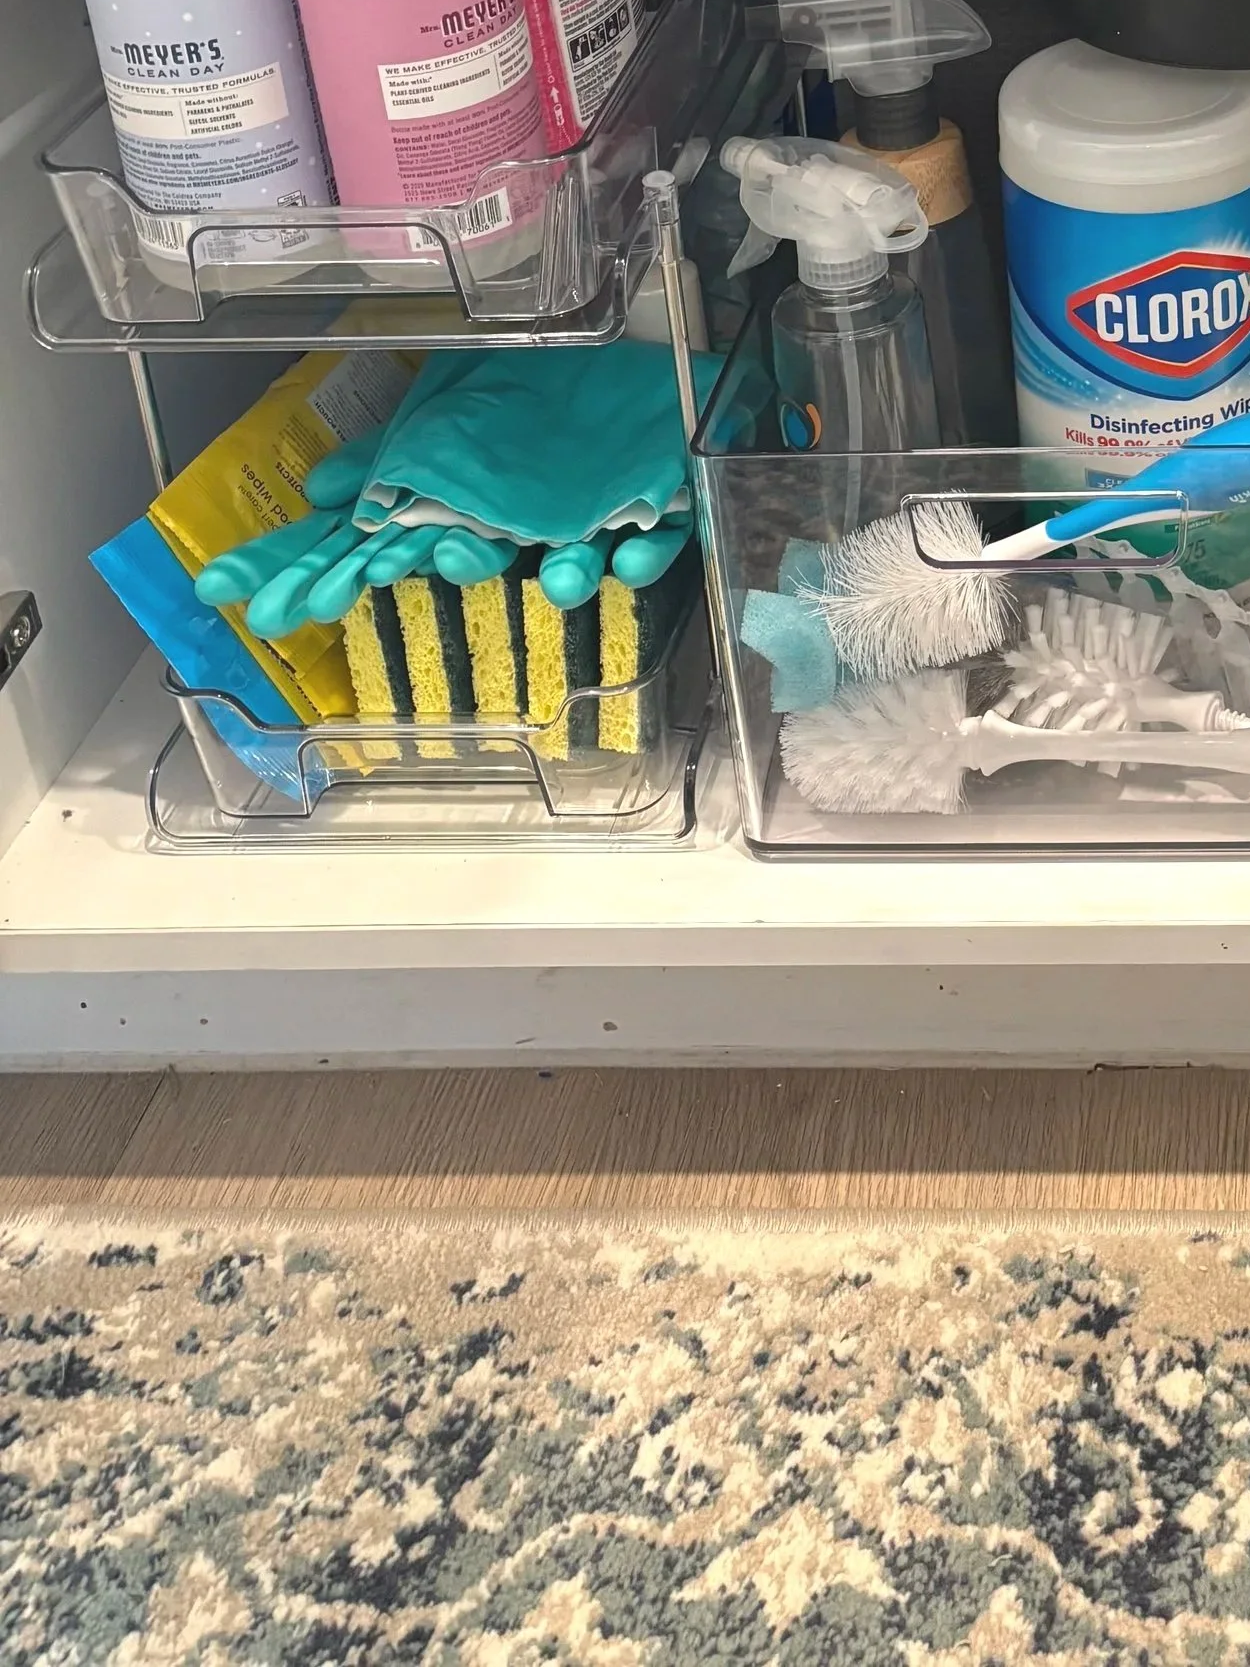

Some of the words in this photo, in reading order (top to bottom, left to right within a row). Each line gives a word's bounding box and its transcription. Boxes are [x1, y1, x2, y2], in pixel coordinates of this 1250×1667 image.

[420, 25, 441, 34] Mrs.
[444, 23, 494, 49] CLEAN
[124, 39, 221, 66] MEYER'S
[403, 64, 432, 73] MAKE
[434, 47, 487, 68] EFFECTIVE,
[489, 27, 517, 50] TRUSTED
[128, 67, 180, 78] CLEAN
[190, 62, 225, 76] DAY
[172, 84, 219, 94] TRUSTED
[389, 80, 409, 88] Made
[421, 96, 434, 104] OILS
[433, 130, 454, 141] reach
[455, 127, 461, 135] of
[462, 120, 488, 133] children
[489, 114, 500, 124] and
[1090, 414, 1214, 434] Disinfecting
[1066, 427, 1093, 446] Kills
[241, 463, 273, 503] wipes
[266, 512, 281, 530] pert
